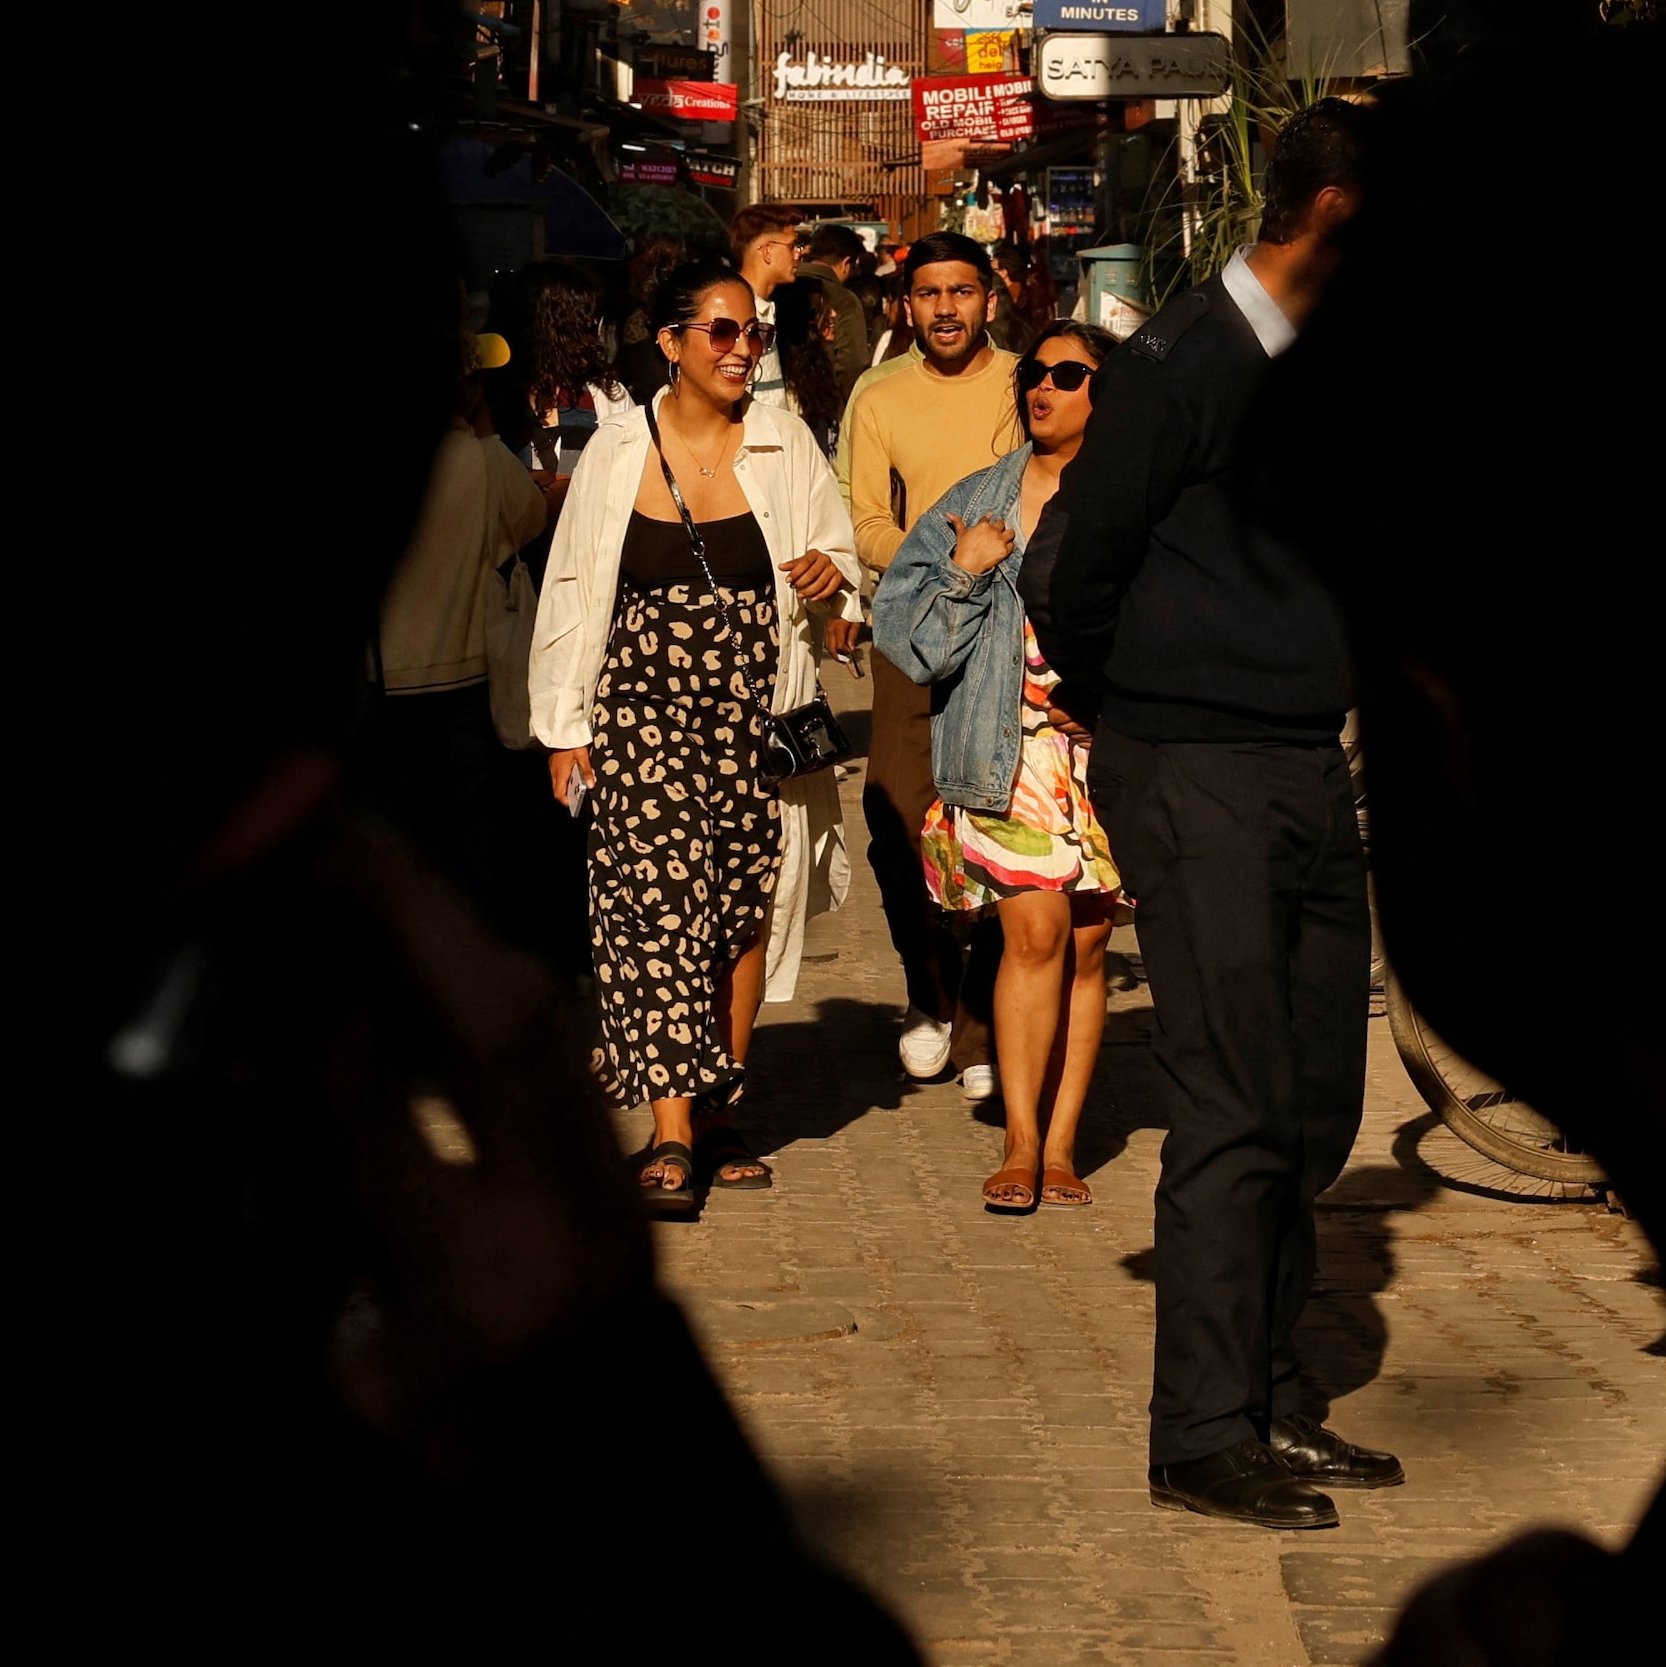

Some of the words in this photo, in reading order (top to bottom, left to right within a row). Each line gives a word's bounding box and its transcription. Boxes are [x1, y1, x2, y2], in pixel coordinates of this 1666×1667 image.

[1061, 6, 1139, 21] MINUTES
[772, 51, 910, 99] fabindia
[1047, 56, 1139, 80] SATYA
[685, 94, 731, 109] Creations
[789, 91, 822, 100] HOME
[846, 90, 908, 100] LIFESTYLE
[921, 120, 949, 131] OLD
[953, 116, 996, 127] MOBIL
